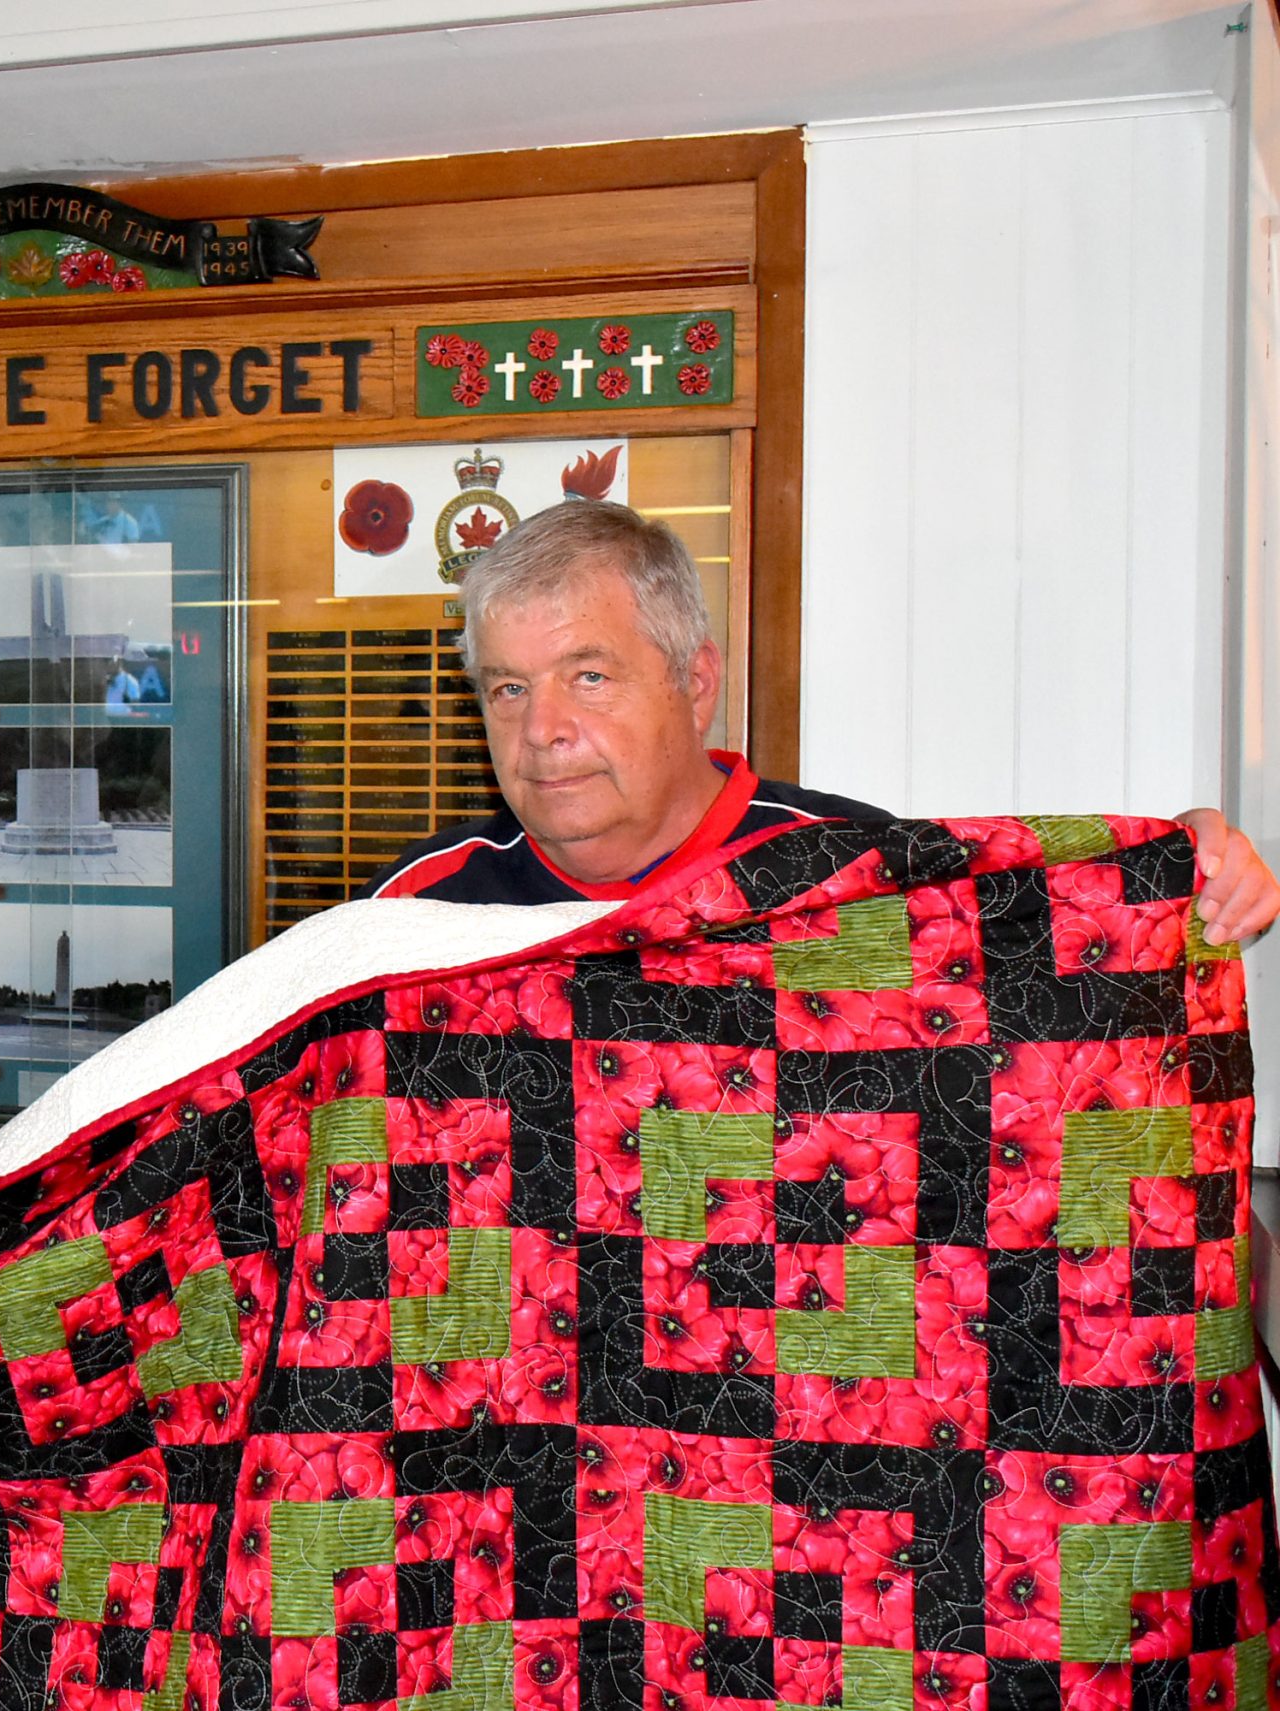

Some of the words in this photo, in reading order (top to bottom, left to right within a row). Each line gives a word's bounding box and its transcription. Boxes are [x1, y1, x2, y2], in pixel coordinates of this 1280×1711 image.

[121, 219, 187, 258] THEM
[203, 241, 248, 256] 1939
[203, 261, 250, 276] 1945
[86, 338, 373, 424] FORGET
[448, 553, 479, 568] LEG
[447, 604, 463, 614] VE
